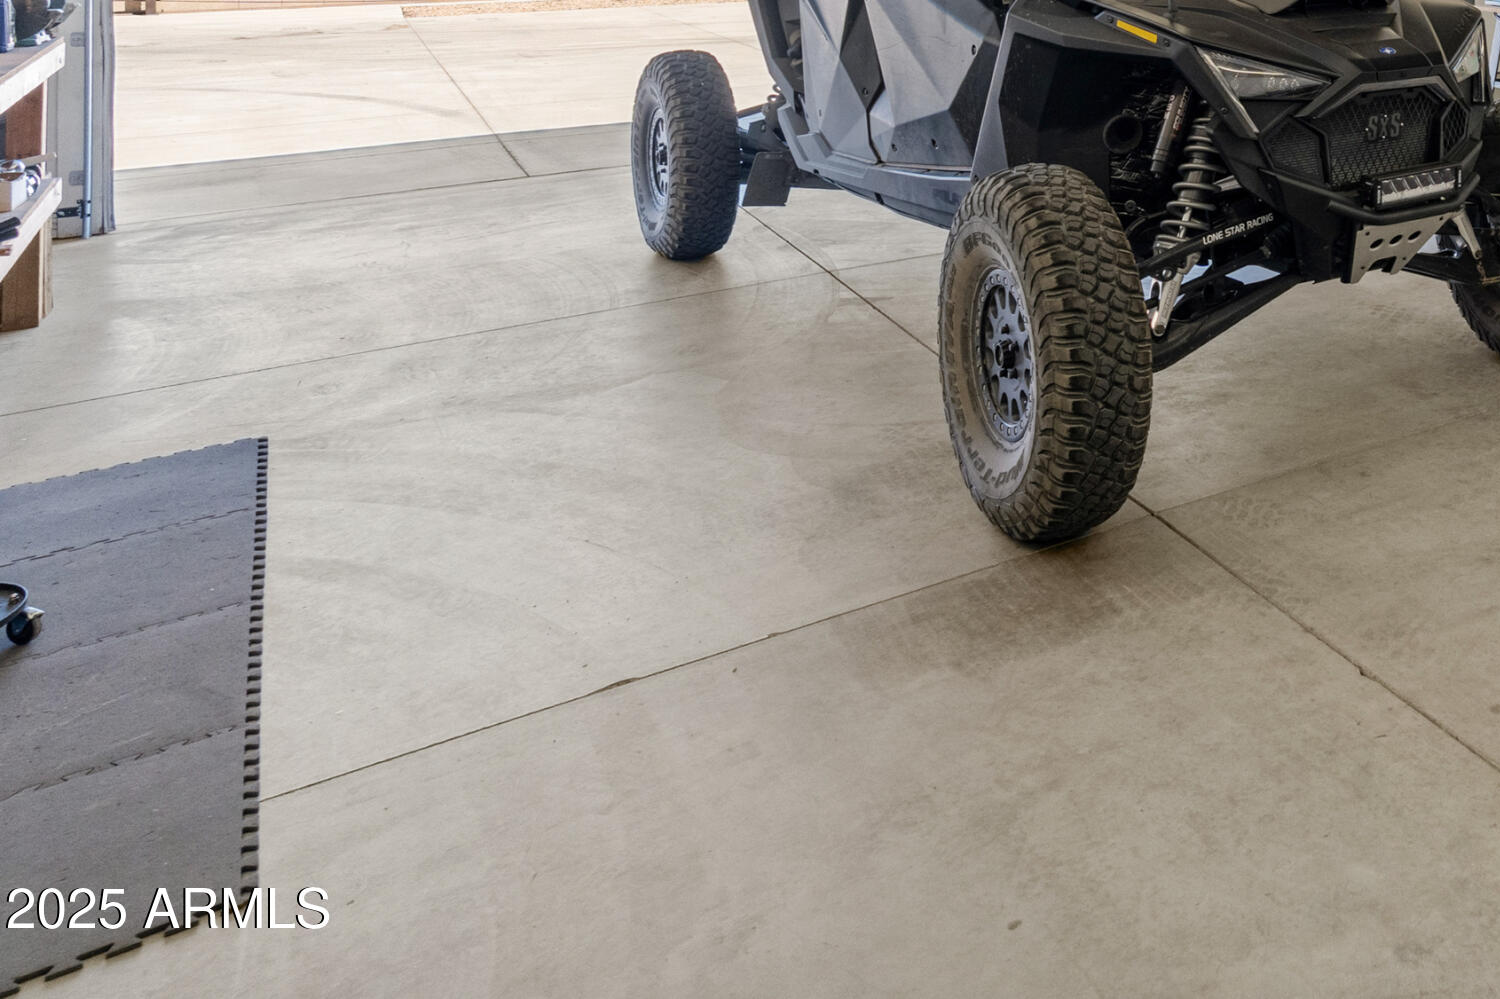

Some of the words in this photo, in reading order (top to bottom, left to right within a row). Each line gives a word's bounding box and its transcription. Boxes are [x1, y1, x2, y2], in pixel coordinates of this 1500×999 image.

[1202, 230, 1224, 246] LONE
[1224, 223, 1246, 237] STAR
[1246, 212, 1274, 230] RACING
